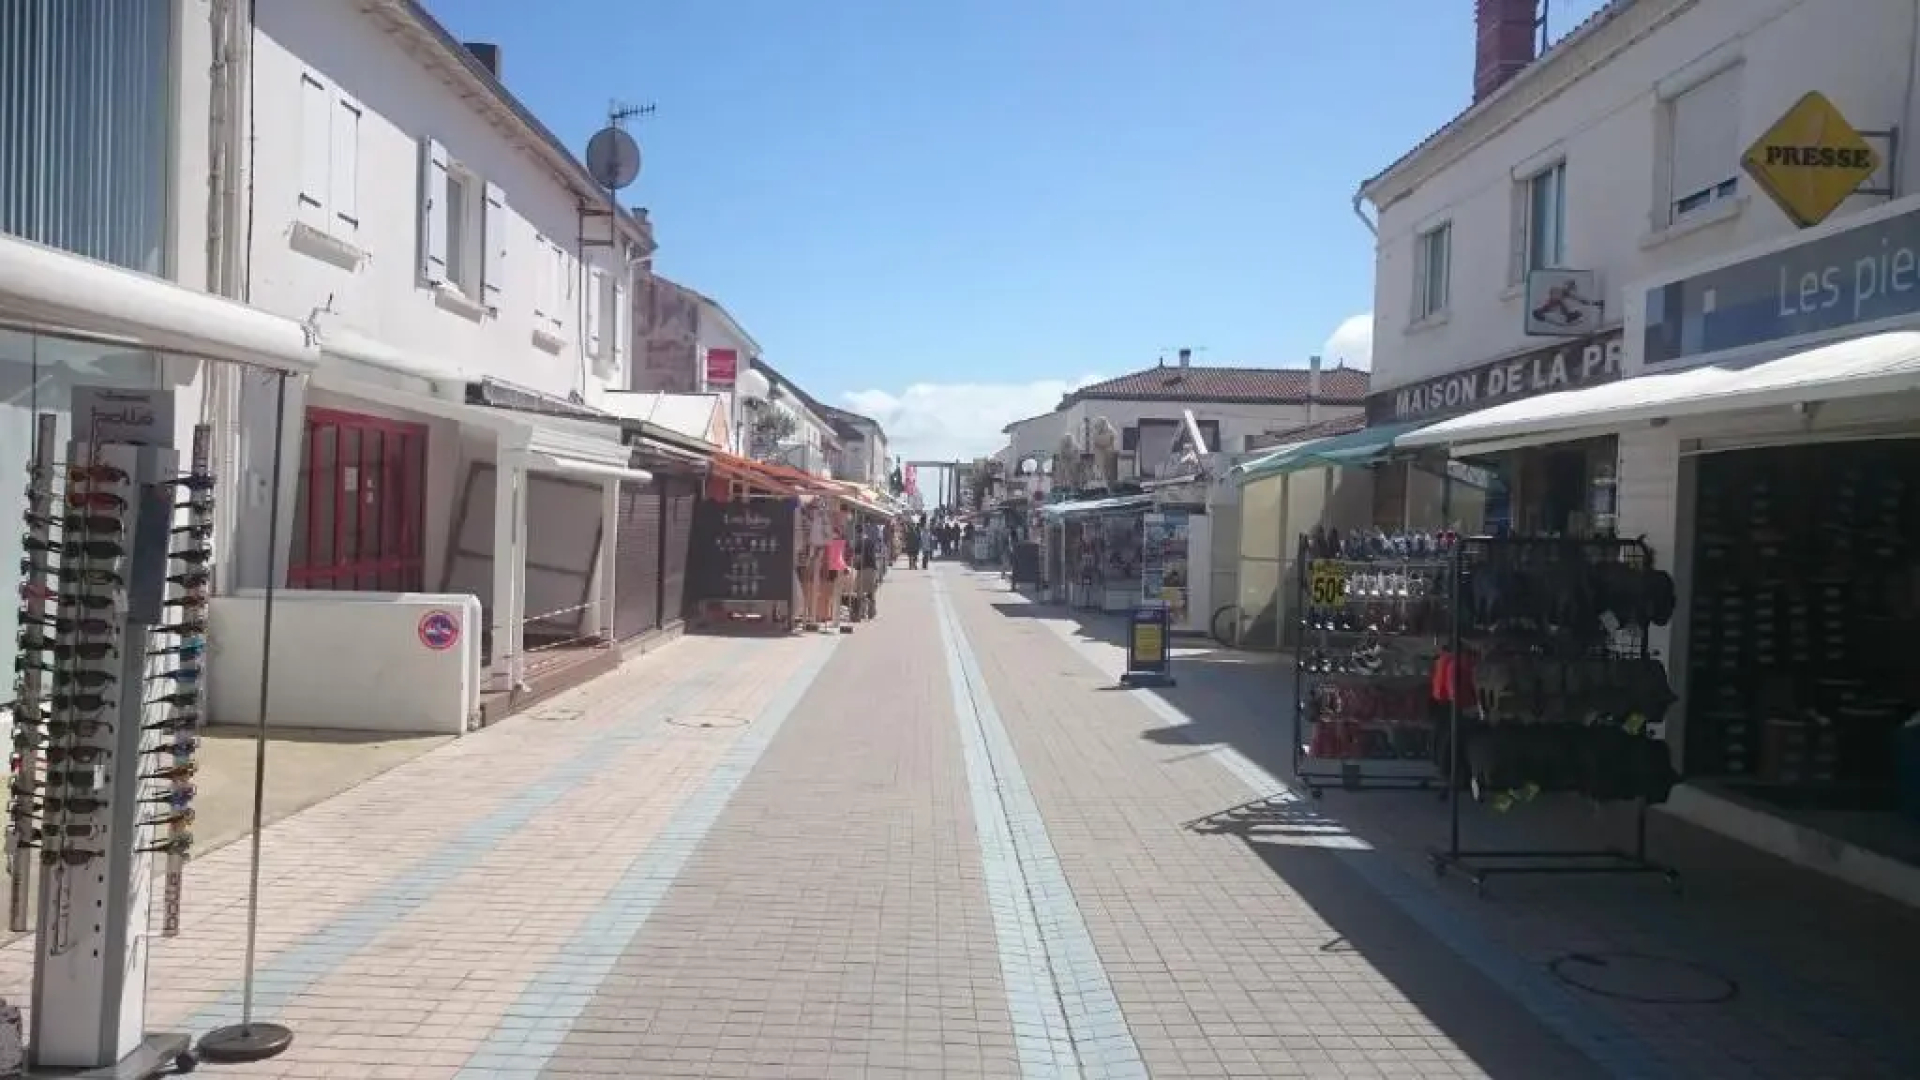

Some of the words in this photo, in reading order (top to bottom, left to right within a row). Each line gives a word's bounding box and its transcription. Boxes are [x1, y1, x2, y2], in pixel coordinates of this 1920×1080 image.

[1766, 146, 1871, 168] PRESSE
[1778, 264, 1841, 317] Les
[1853, 237, 1920, 321] pie
[1395, 374, 1477, 420] MAISON
[1486, 363, 1525, 397] DE
[1532, 350, 1567, 391] LA
